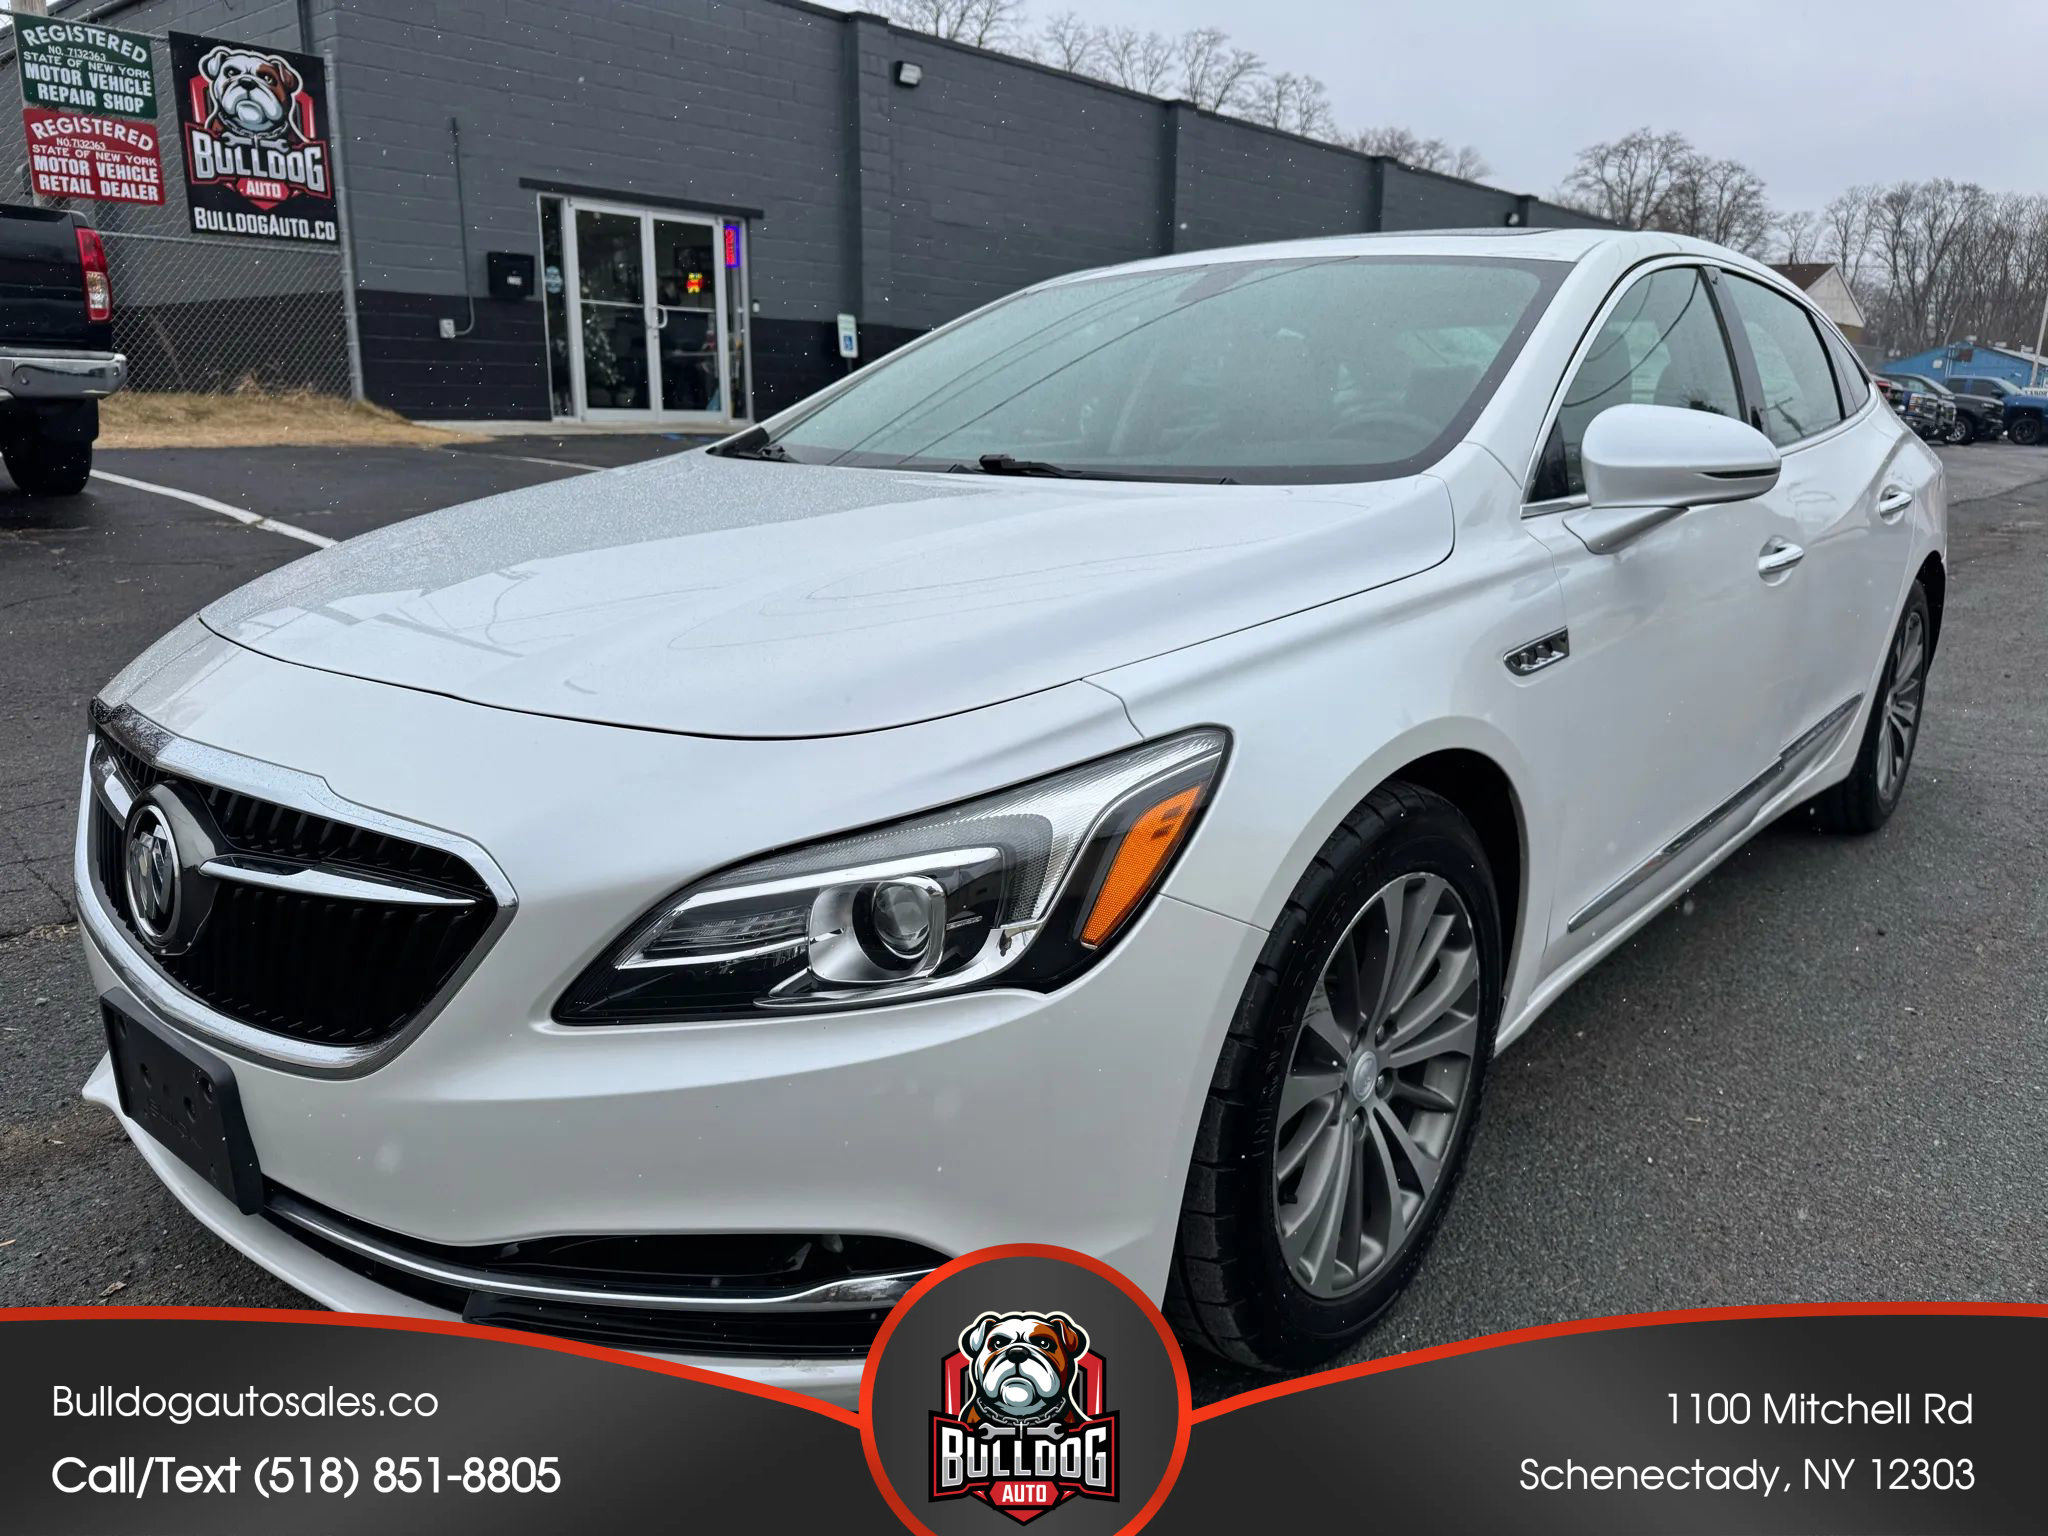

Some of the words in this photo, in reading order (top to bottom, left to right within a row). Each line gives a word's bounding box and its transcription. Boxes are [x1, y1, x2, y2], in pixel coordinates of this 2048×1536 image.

[22, 25, 147, 63] REGISTERED
[24, 51, 62, 66] STATE
[67, 58, 82, 68] OF
[88, 61, 114, 73] NEW
[118, 66, 150, 79] YORK
[25, 63, 82, 86] MOTOR
[88, 72, 153, 97] VEHICLE
[37, 83, 96, 107] REPAIR
[103, 93, 144, 113] SHOP
[30, 117, 153, 151] REGISTERED
[32, 144, 69, 157] STATE
[75, 149, 90, 159] OF
[95, 152, 121, 163] NEW
[125, 155, 157, 167] YORK
[33, 155, 90, 177] MOTOR
[96, 162, 159, 183] VEHICLE
[192, 130, 325, 192] BULLDOG
[39, 174, 96, 195] RETAIL
[101, 181, 159, 201] DEALER
[245, 181, 281, 198] AUTO
